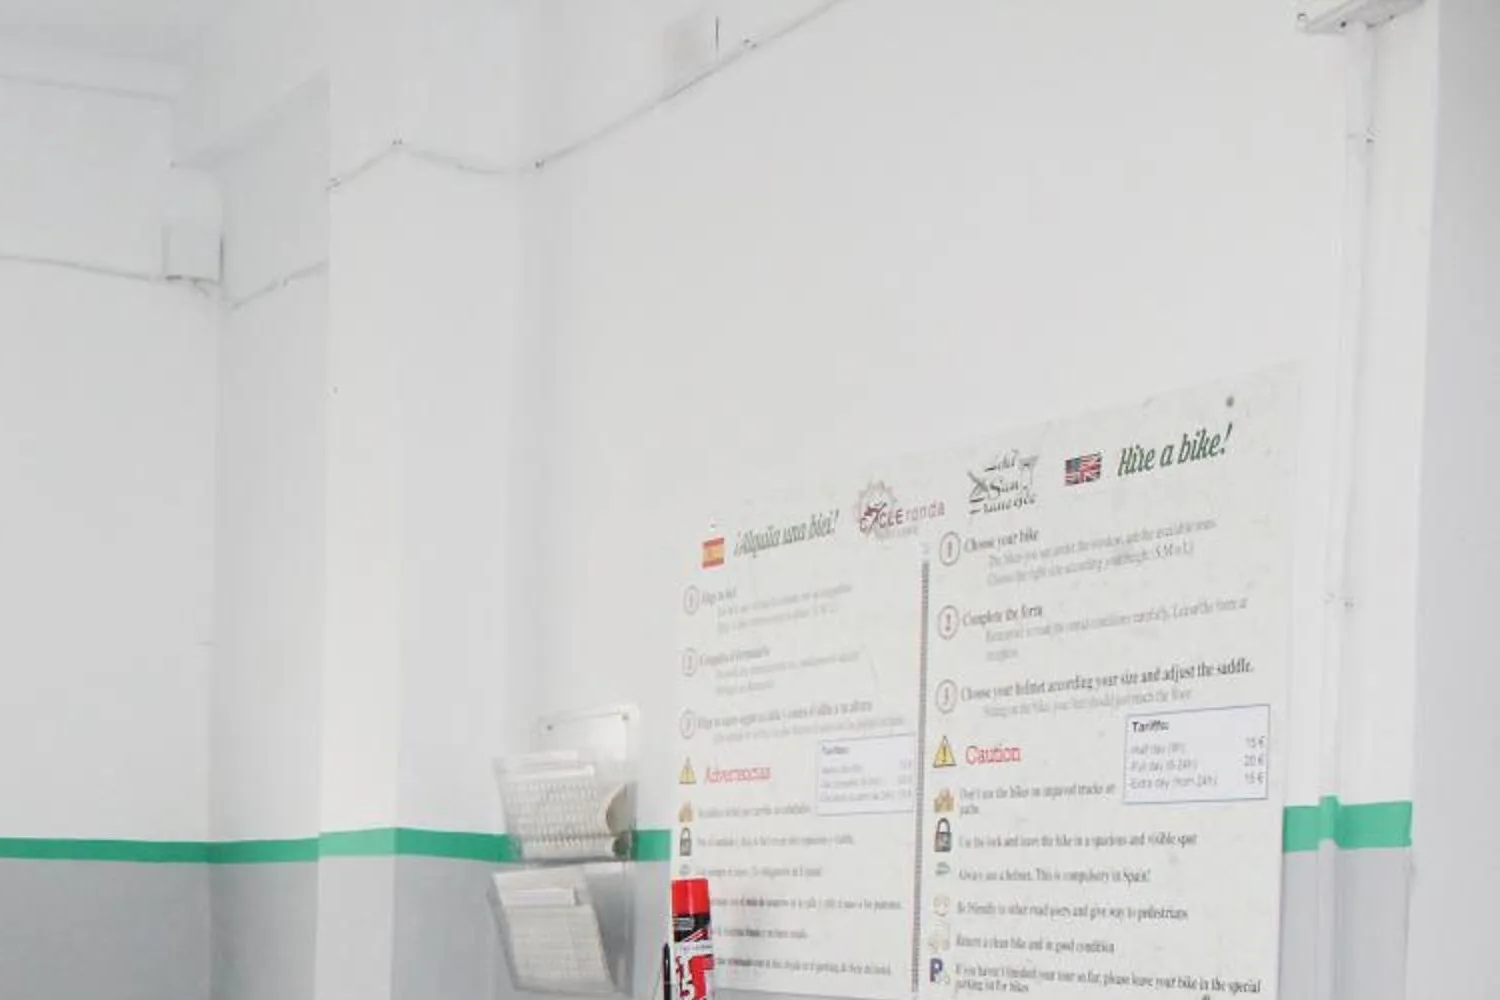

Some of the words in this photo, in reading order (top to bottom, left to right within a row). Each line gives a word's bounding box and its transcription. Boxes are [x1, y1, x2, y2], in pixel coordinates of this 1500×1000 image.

[1117, 444, 1156, 477] Hire
[1159, 444, 1175, 468] a
[1177, 421, 1233, 465] bike!
[1141, 665, 1161, 683] and
[1162, 663, 1196, 686] adjust
[1197, 661, 1215, 678] the
[965, 744, 1023, 766] Caution
[1228, 977, 1261, 996] special
